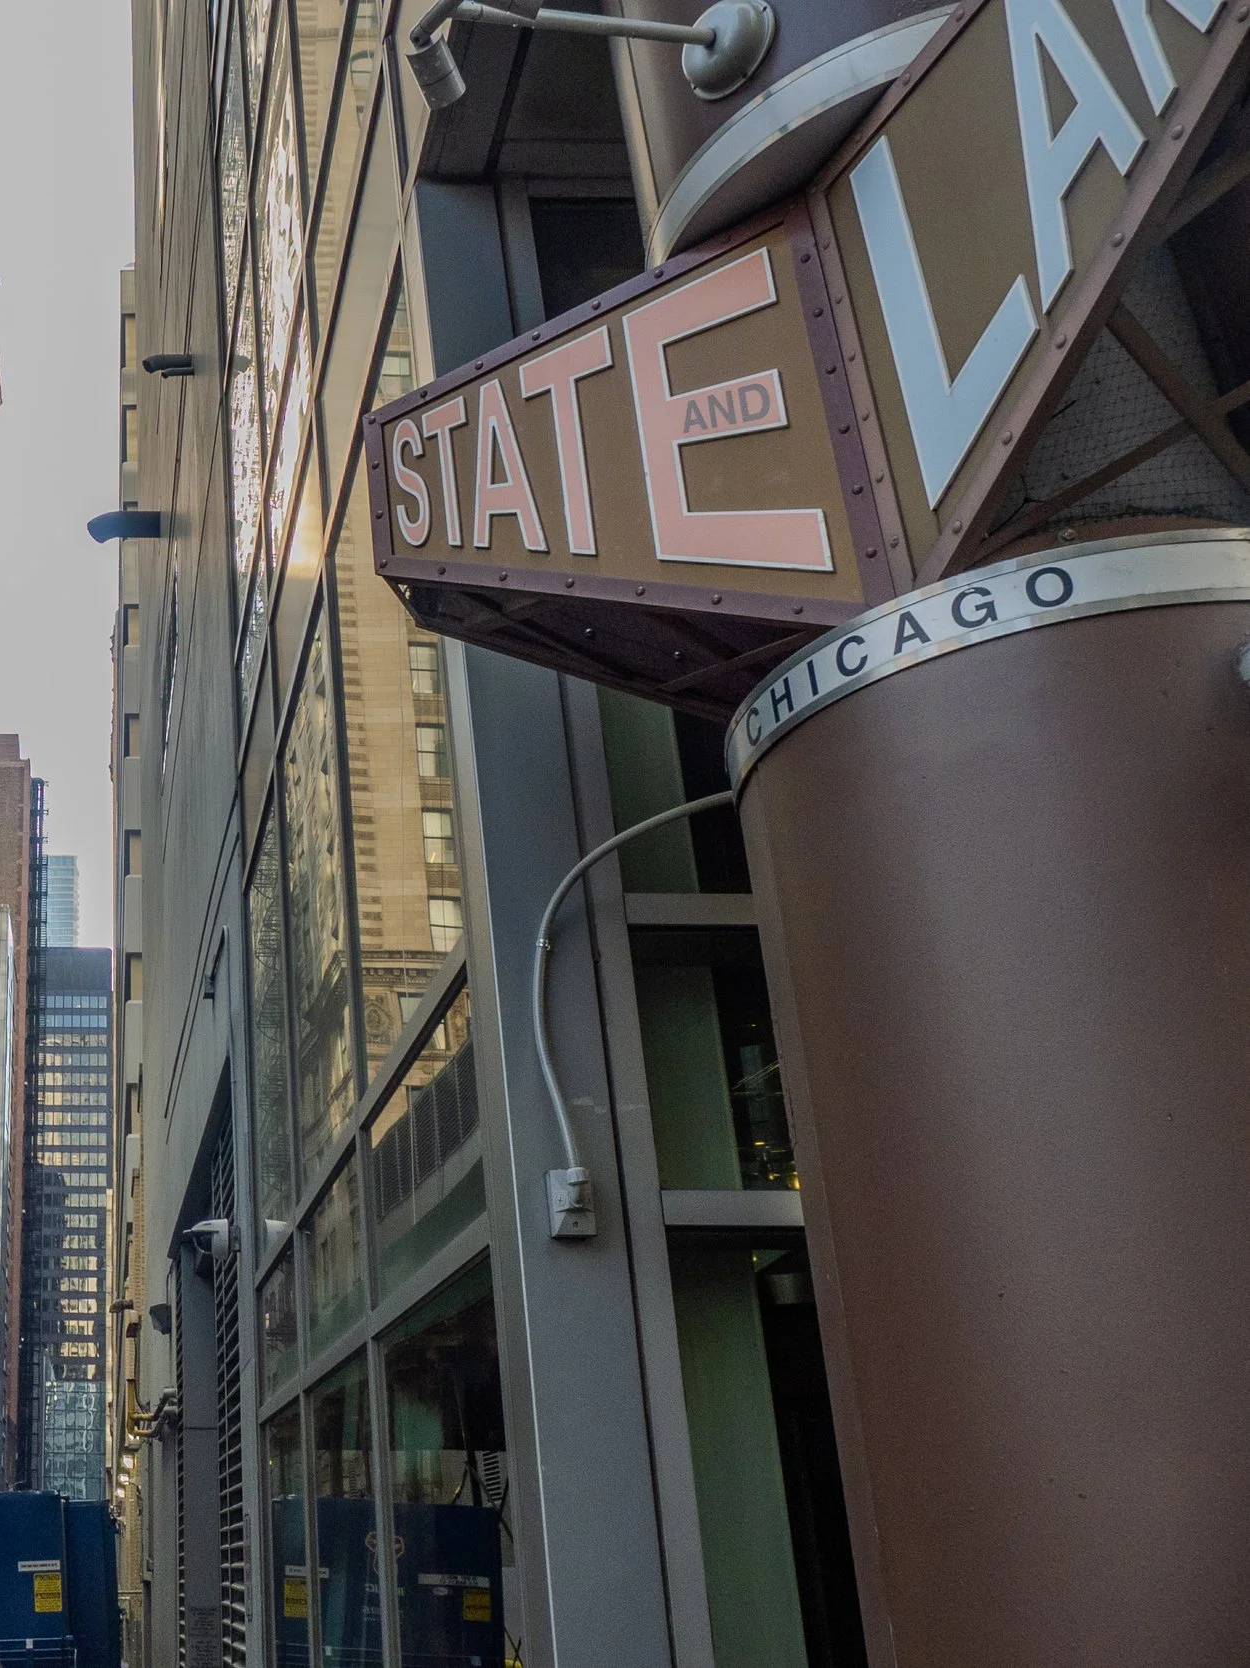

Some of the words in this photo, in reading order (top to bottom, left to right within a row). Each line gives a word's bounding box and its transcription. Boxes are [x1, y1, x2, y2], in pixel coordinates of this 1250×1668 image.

[393, 247, 834, 572] STATE
[682, 383, 771, 433] AND
[745, 566, 1074, 747] CHICAGO
